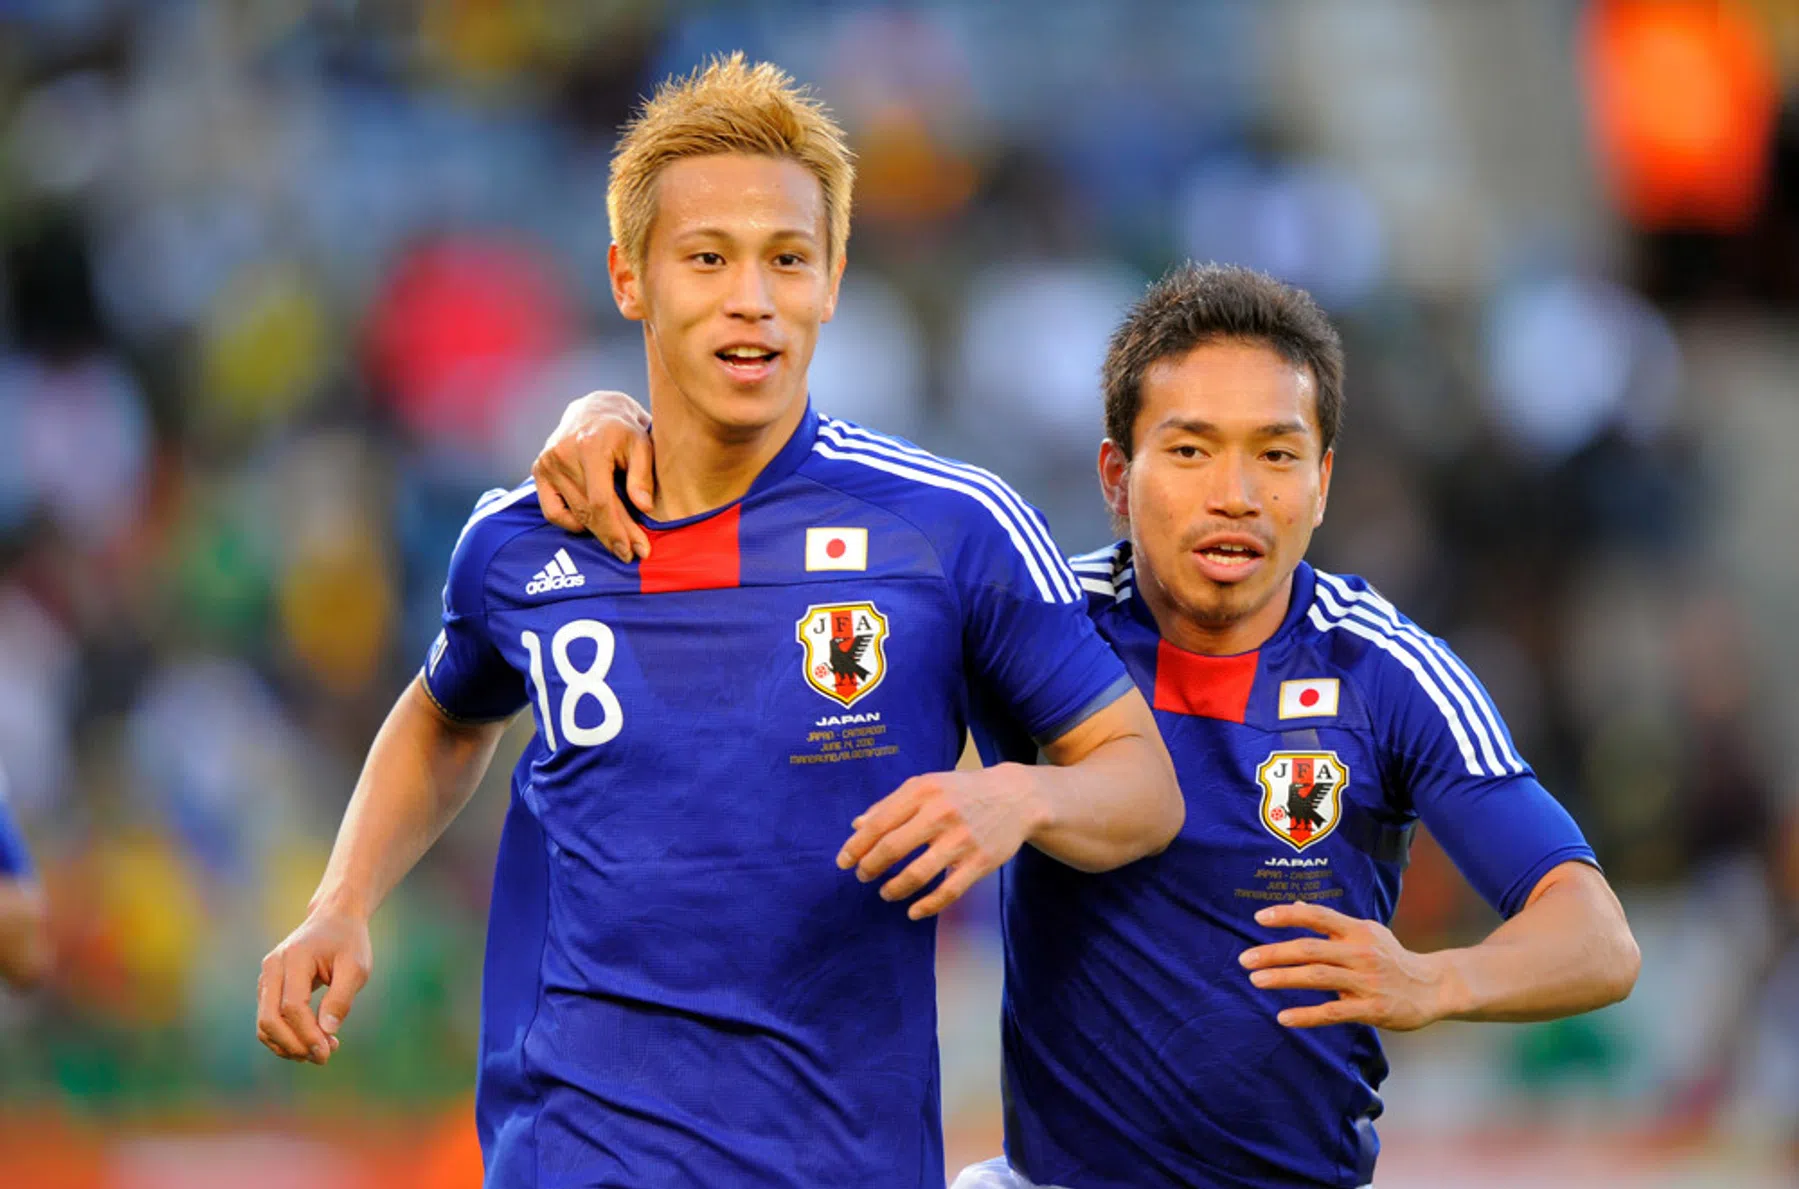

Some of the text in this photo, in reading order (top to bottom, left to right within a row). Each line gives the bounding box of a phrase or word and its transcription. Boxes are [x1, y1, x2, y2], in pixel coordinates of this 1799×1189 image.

[525, 573, 586, 595] adidas
[521, 619, 624, 752] 18
[815, 712, 880, 726] JAPAN
[1264, 857, 1329, 867] JAPAN
